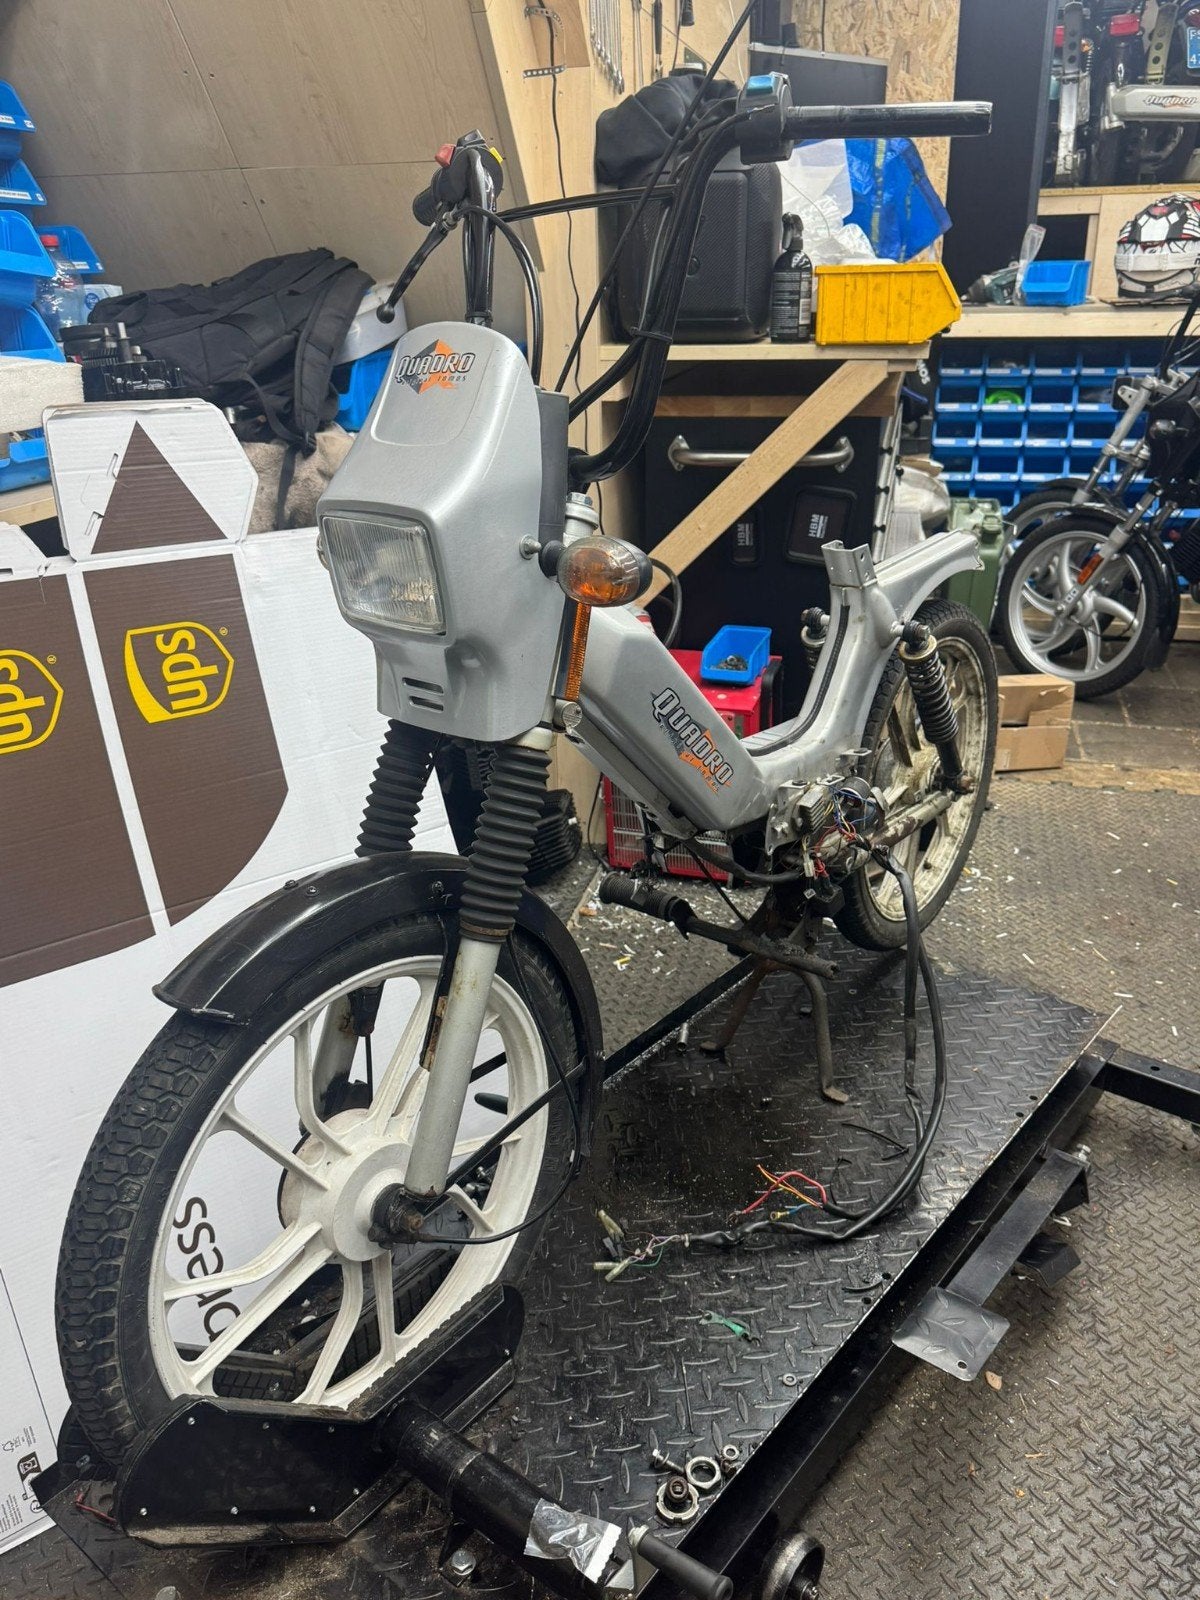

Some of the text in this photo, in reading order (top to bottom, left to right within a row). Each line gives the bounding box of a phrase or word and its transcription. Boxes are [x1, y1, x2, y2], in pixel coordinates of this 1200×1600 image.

[394, 352, 477, 384] QUADRO
[807, 513, 820, 537] HBM
[155, 629, 219, 711] ups
[651, 687, 735, 786] QUADRO
